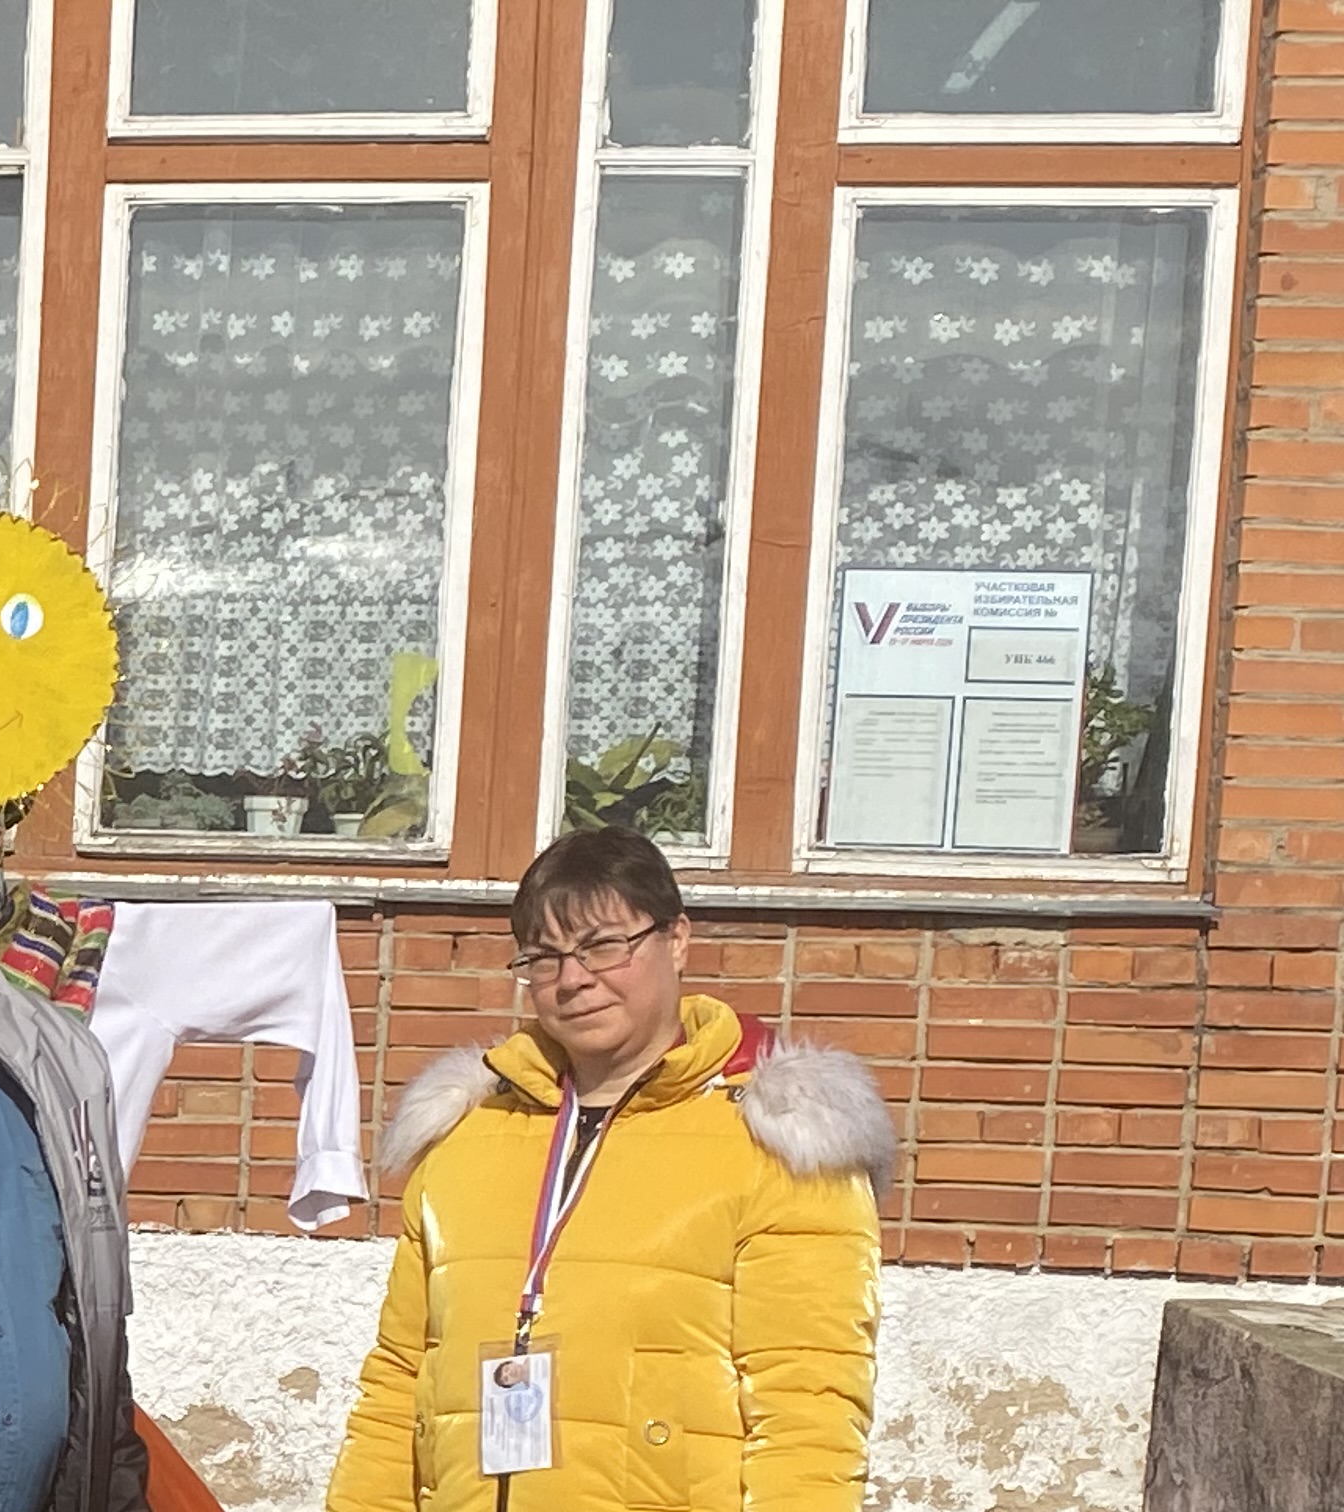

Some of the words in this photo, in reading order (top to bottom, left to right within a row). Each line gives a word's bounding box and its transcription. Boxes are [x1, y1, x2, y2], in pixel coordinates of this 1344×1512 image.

[974, 581, 1055, 592] УЧАСТКОВАЯ
[973, 594, 1078, 606] ИЗБИРАТЕЛЬНАЯ
[972, 607, 1041, 617] КОМИССИЯ
